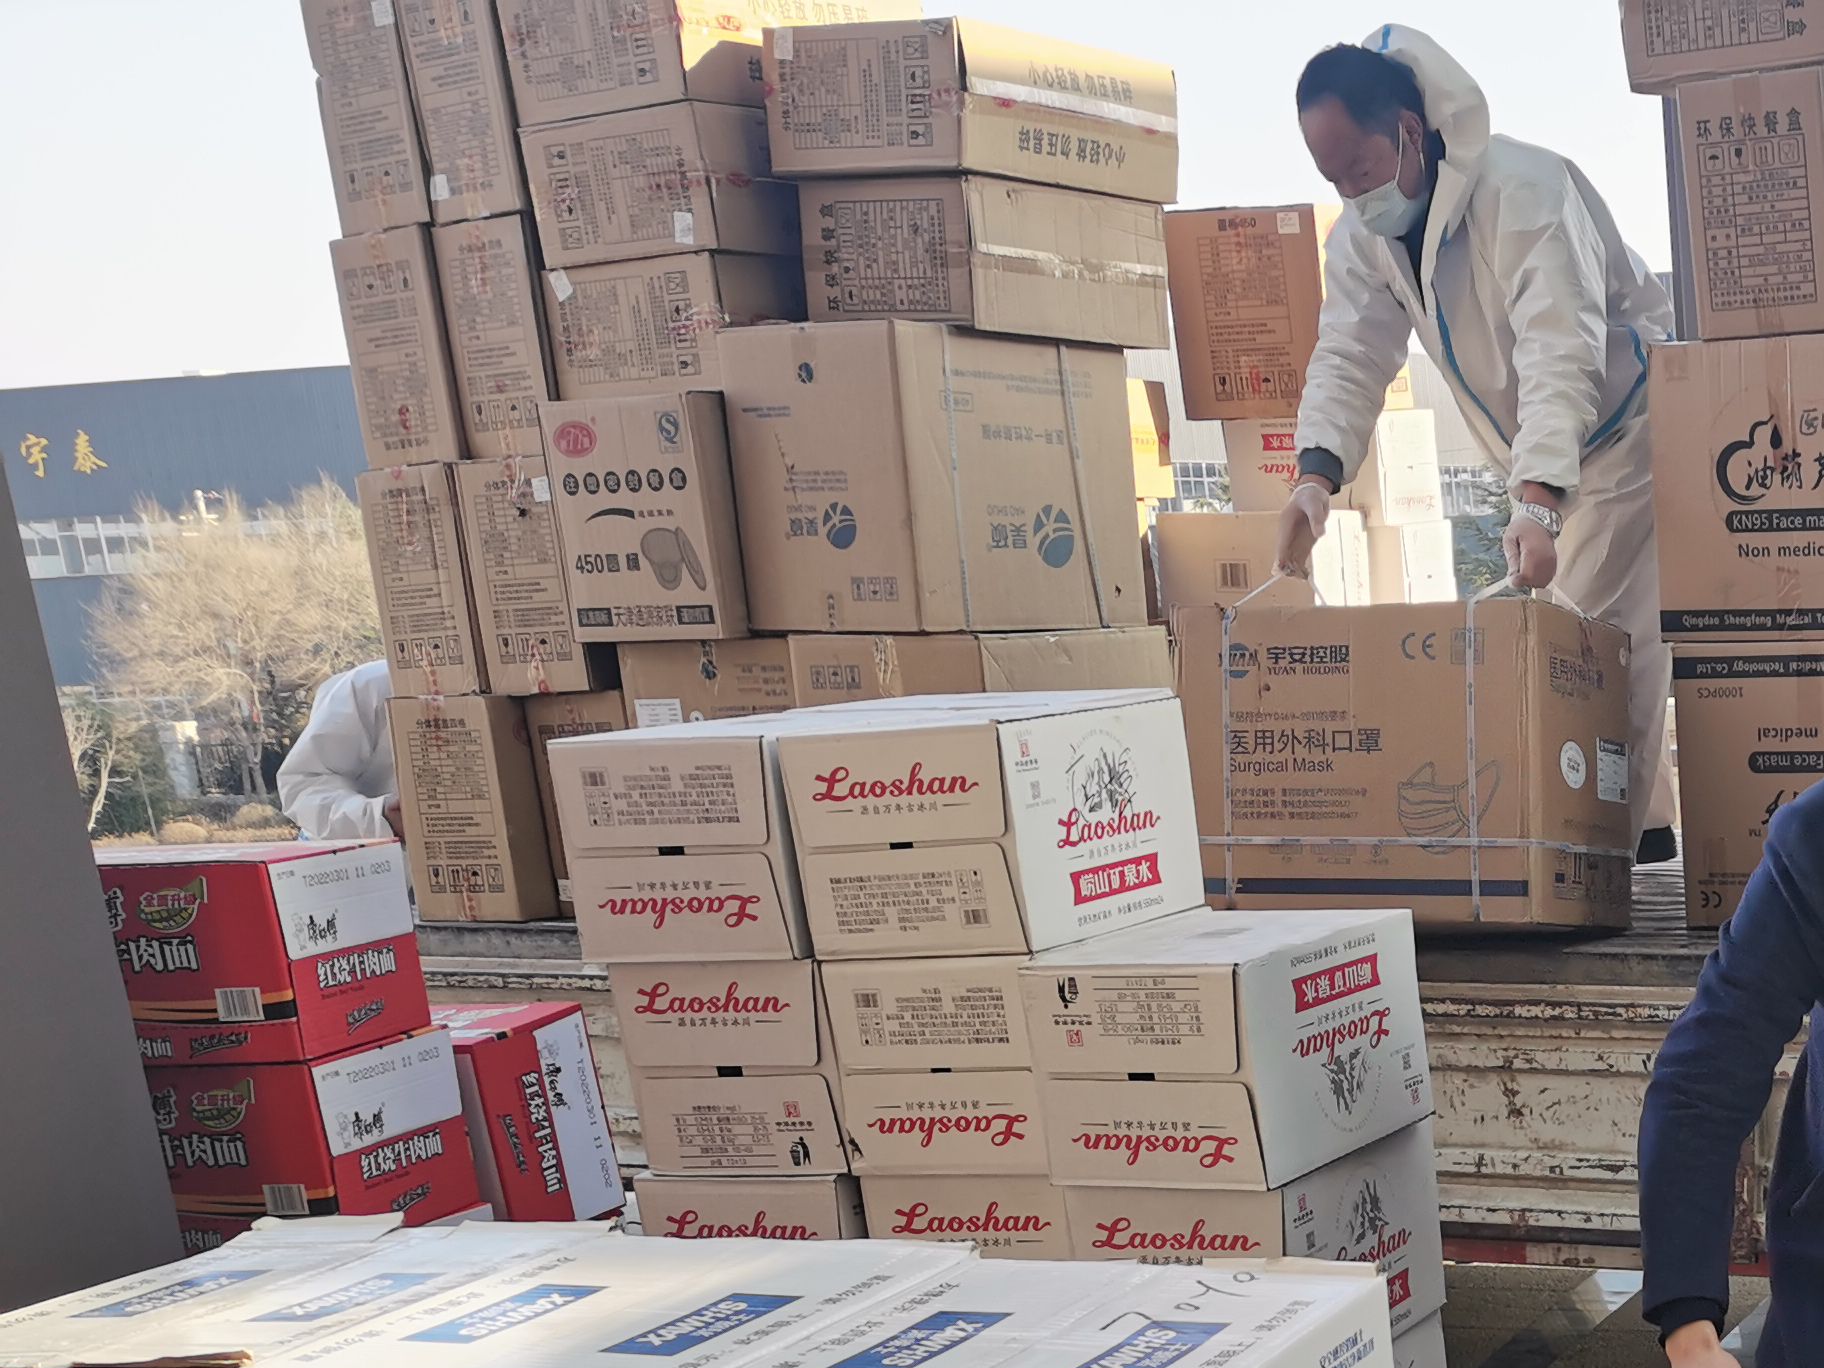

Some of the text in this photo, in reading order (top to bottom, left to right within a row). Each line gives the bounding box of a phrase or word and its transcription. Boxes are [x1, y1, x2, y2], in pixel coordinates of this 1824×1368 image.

[1696, 107, 1804, 141] 环保快餐盒
[1732, 513, 1770, 530] KN95
[1773, 513, 1802, 529] Face
[1738, 543, 1772, 558] Non
[1682, 615, 1720, 627] Qingdao
[1724, 613, 1772, 627] Shengfeng
[1266, 644, 1350, 664] 宇安控股
[1401, 632, 1437, 660] CE
[1302, 664, 1350, 676] HOLDING
[1732, 661, 1785, 674] Technology
[1697, 686, 1744, 698] 1000PCS
[1229, 728, 1383, 755] 医用外科口罩
[1757, 727, 1818, 743] medical
[1228, 757, 1335, 776] Surgical Mask
[1756, 754, 1823, 769] Face mask
[813, 762, 979, 801] Laoshan
[1079, 859, 1152, 897] 崂山矿泉水
[598, 894, 761, 929] Laoshan
[317, 946, 396, 989] 红烧牛肉面
[634, 981, 791, 1014] Laoshan
[1292, 1007, 1391, 1066] Laoshan
[519, 1069, 565, 1194] 红烧牛肉面
[866, 1114, 1028, 1148] Laoshan
[359, 1128, 444, 1181] 红烧牛肉面
[1071, 1133, 1239, 1169] Laoshan
[891, 1201, 1052, 1235] Laoshan
[1091, 1217, 1261, 1252] Laoshan
[634, 1301, 751, 1348] XAWHIS
